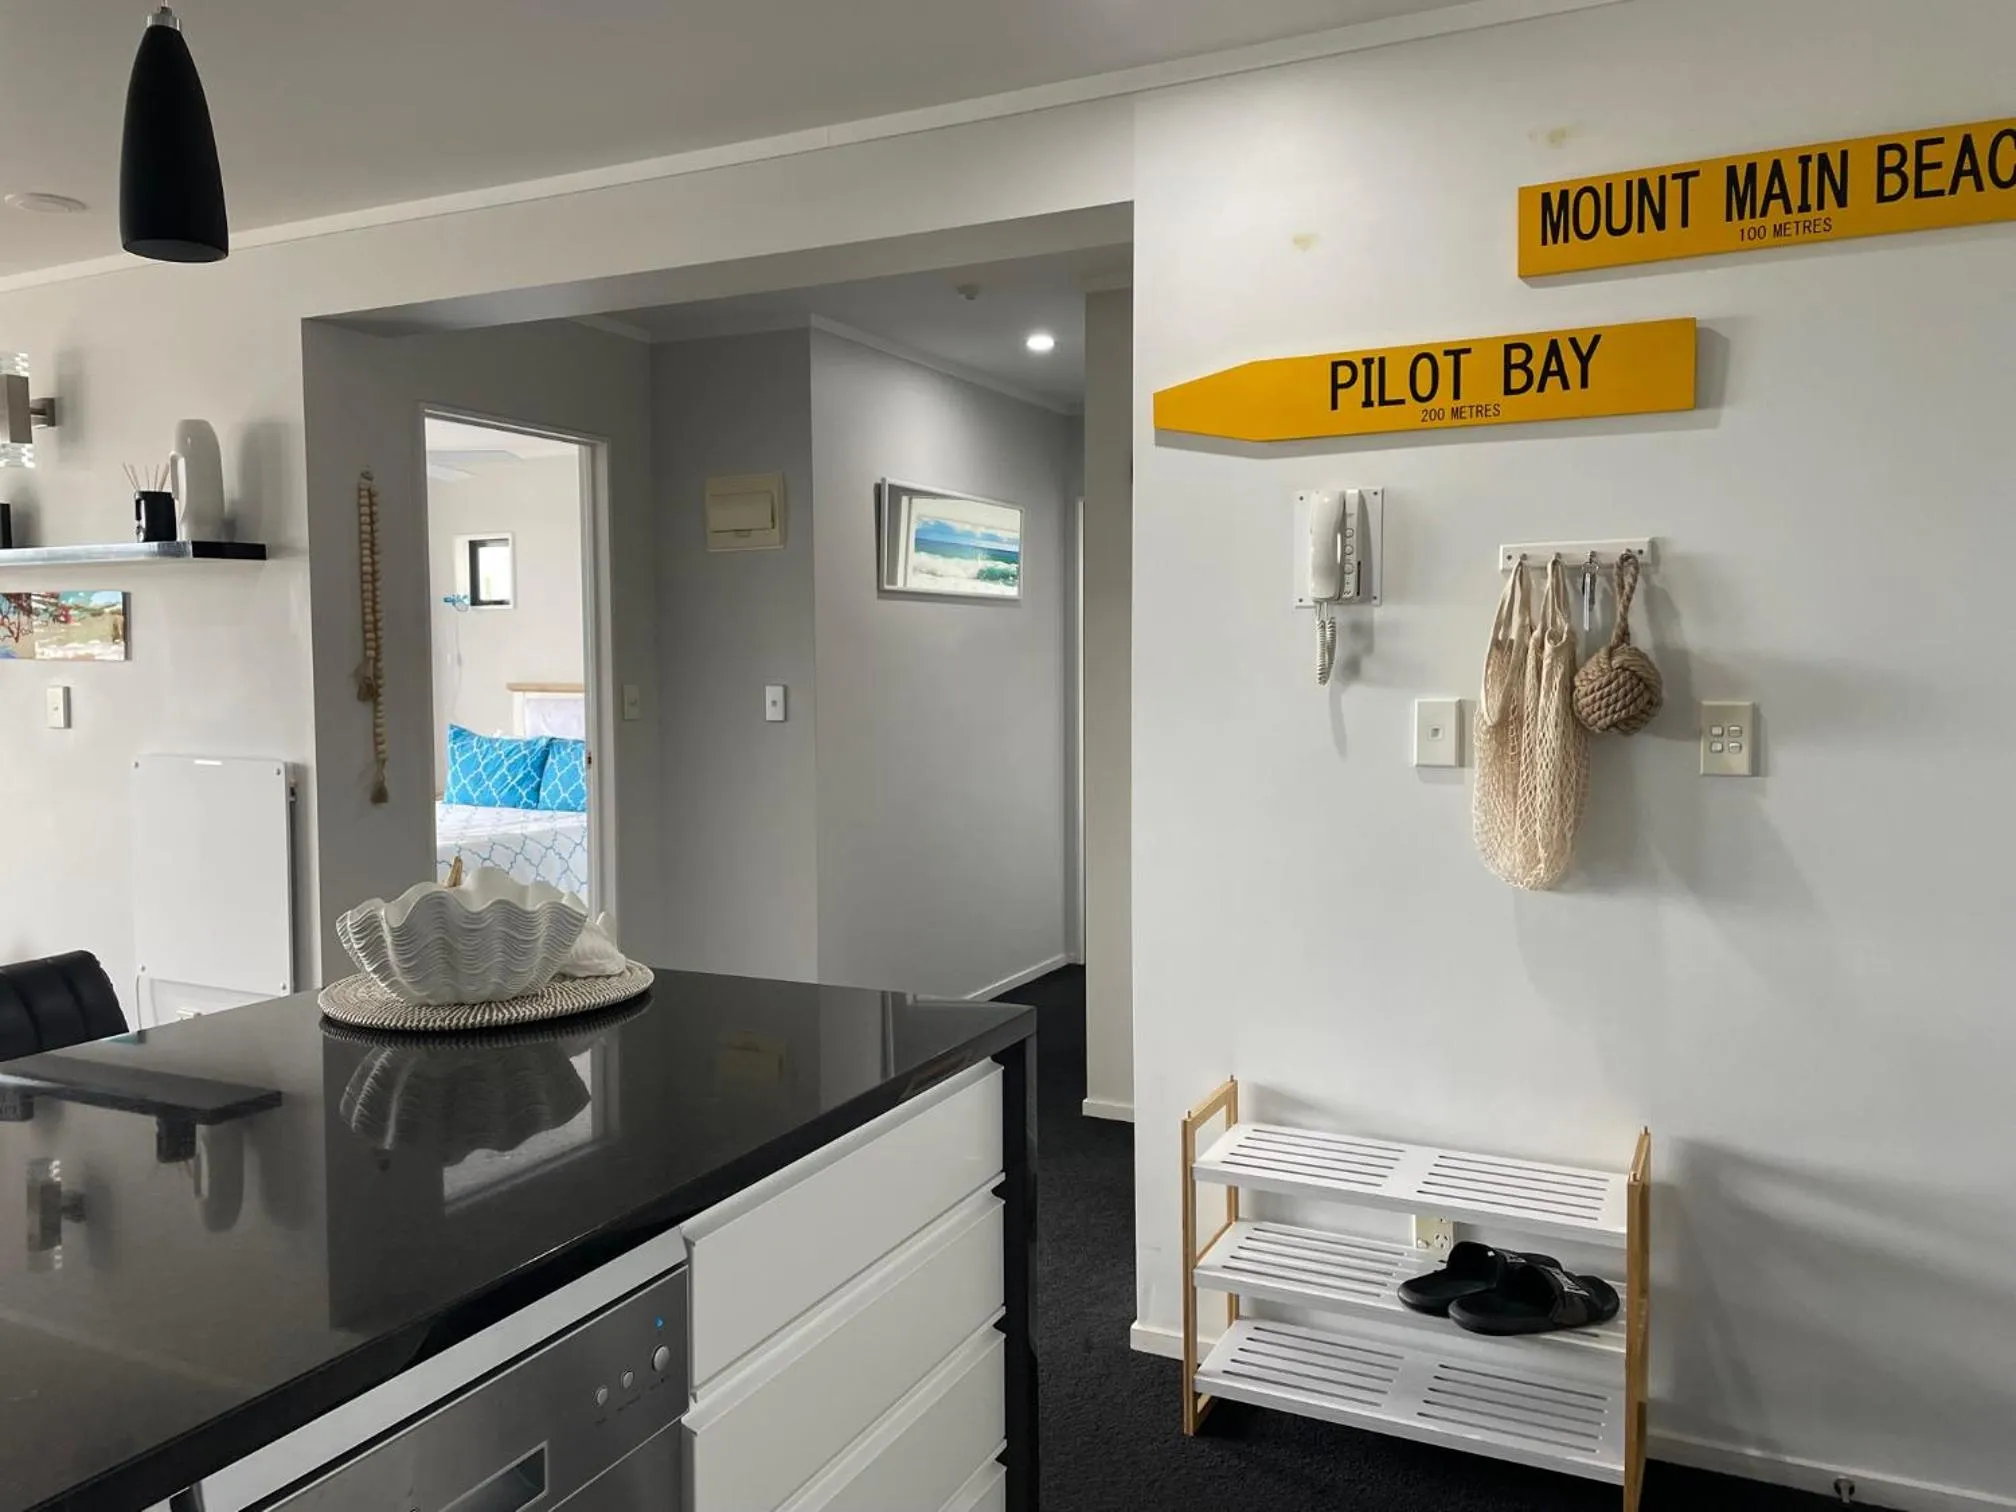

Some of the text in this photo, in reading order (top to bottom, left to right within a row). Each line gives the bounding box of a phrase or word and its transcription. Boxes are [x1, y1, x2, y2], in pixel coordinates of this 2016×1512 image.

[1541, 128, 2016, 246] MOUNT MAIN BEAC
[1739, 217, 1833, 242] 100 METRES
[1330, 334, 1602, 411] PILOT BAY
[1420, 403, 1502, 423] 200 METRES
